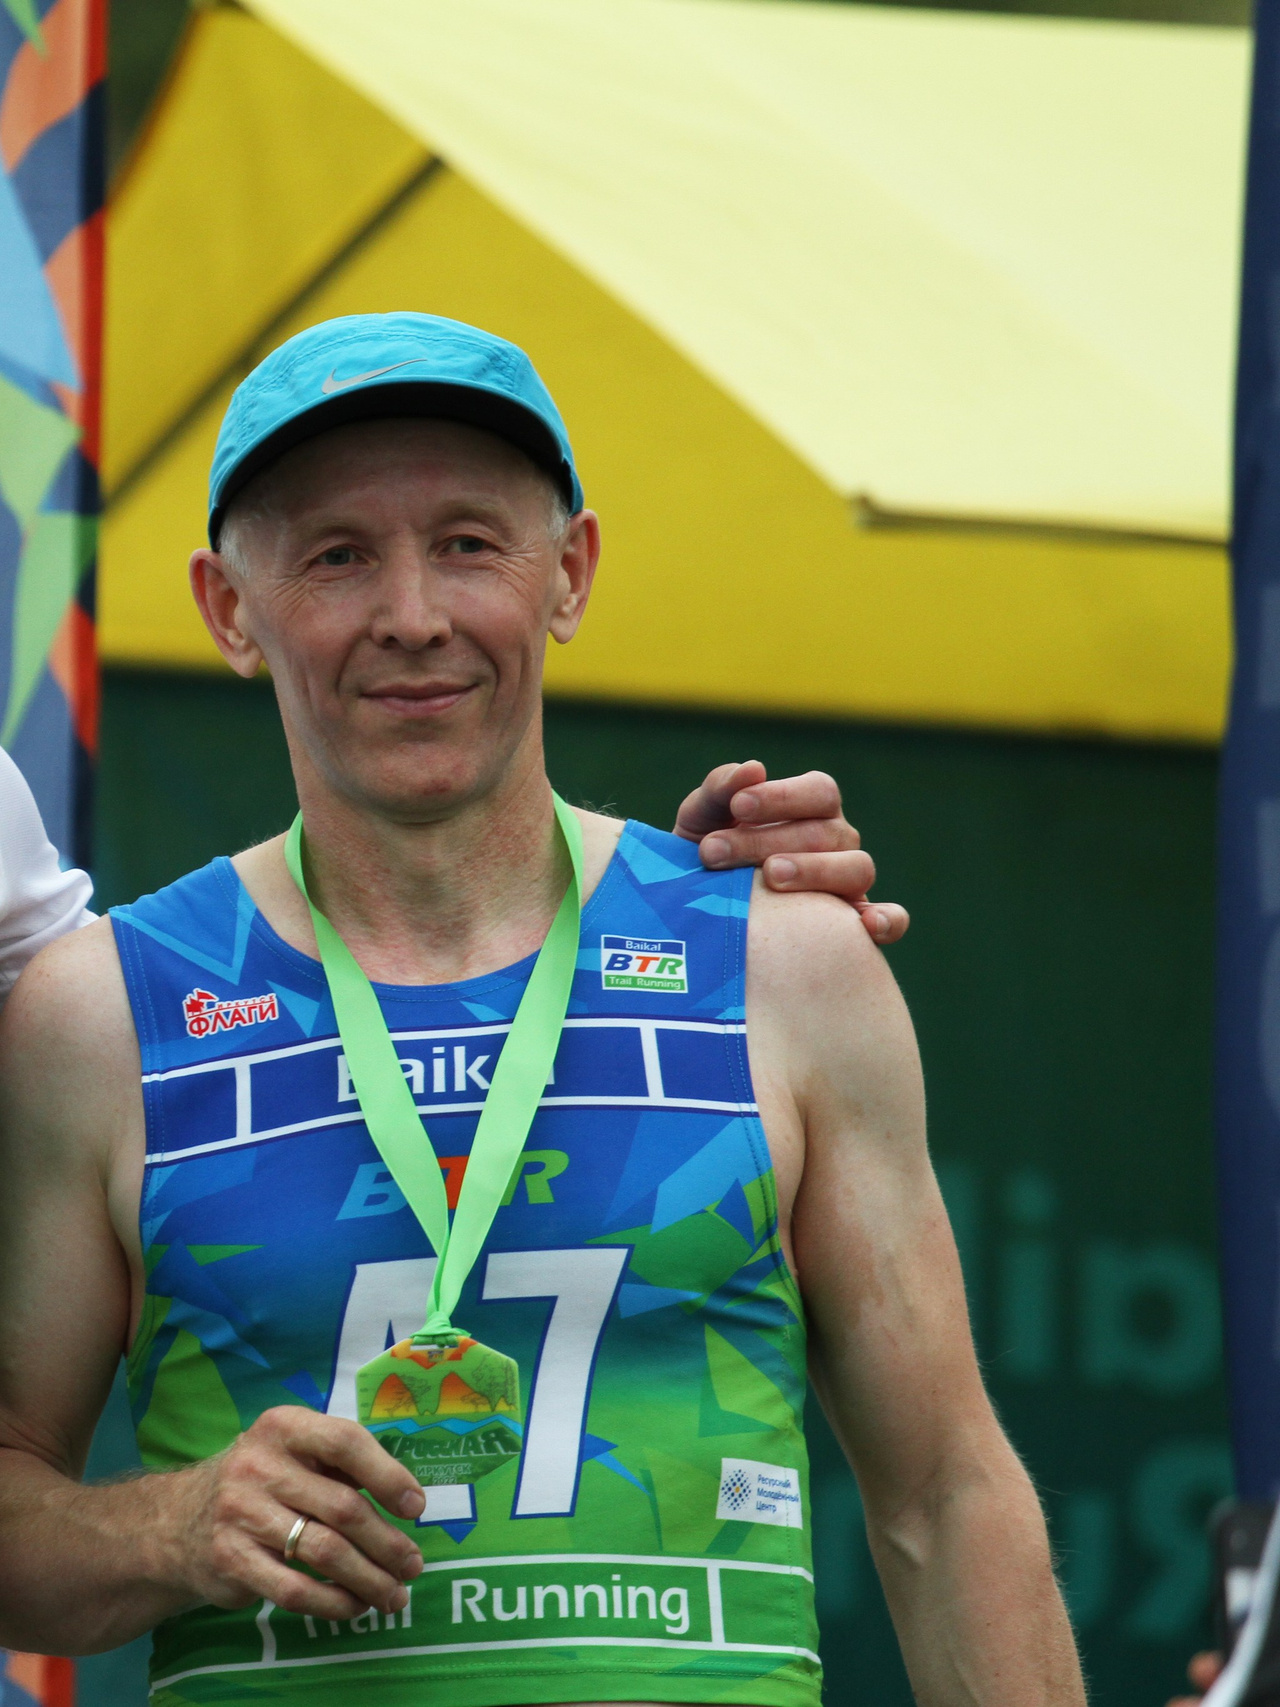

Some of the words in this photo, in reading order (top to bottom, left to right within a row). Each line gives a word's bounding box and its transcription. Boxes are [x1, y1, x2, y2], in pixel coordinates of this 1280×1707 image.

[625, 940, 662, 952] Baikal
[605, 953, 684, 975] BTR
[609, 976, 633, 986] Trail
[636, 977, 682, 990] Running
[217, 995, 275, 1009] ИРКУТСК
[188, 1003, 277, 1037] ФЛАГИ
[335, 1149, 570, 1221] BTR
[415, 1463, 472, 1477] ИРКУТСК
[755, 1500, 778, 1514] Центр
[451, 1574, 690, 1635] Running
